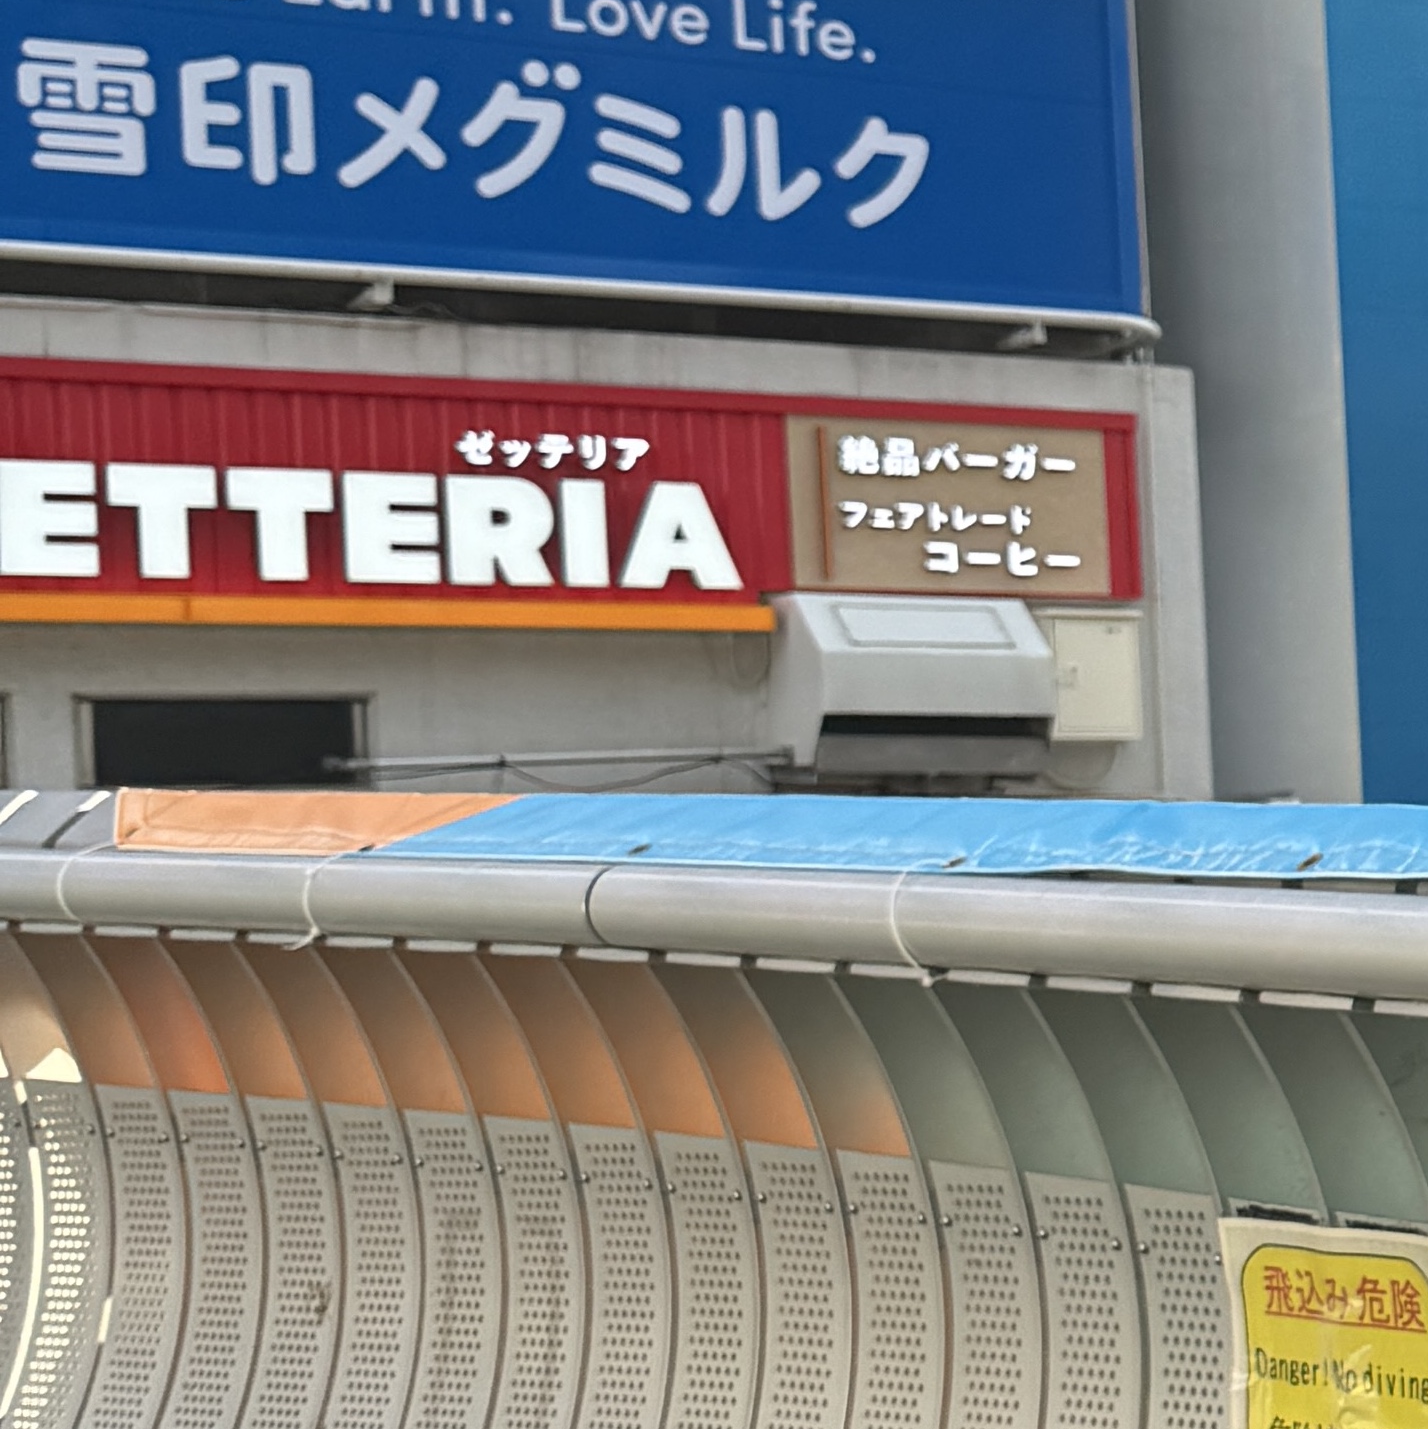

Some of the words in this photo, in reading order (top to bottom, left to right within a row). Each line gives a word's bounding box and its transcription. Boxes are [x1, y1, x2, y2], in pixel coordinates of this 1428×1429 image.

[17, 36, 930, 229] 雪印メグミルク
[454, 429, 650, 472] ゼッテリア
[836, 434, 1077, 482] 絶品バーガー
[0, 457, 745, 592] ETTERIA
[837, 500, 1031, 536] フェアトレード
[923, 540, 1082, 578] コーヒー
[1263, 1265, 1426, 1329] 飛込み危険
